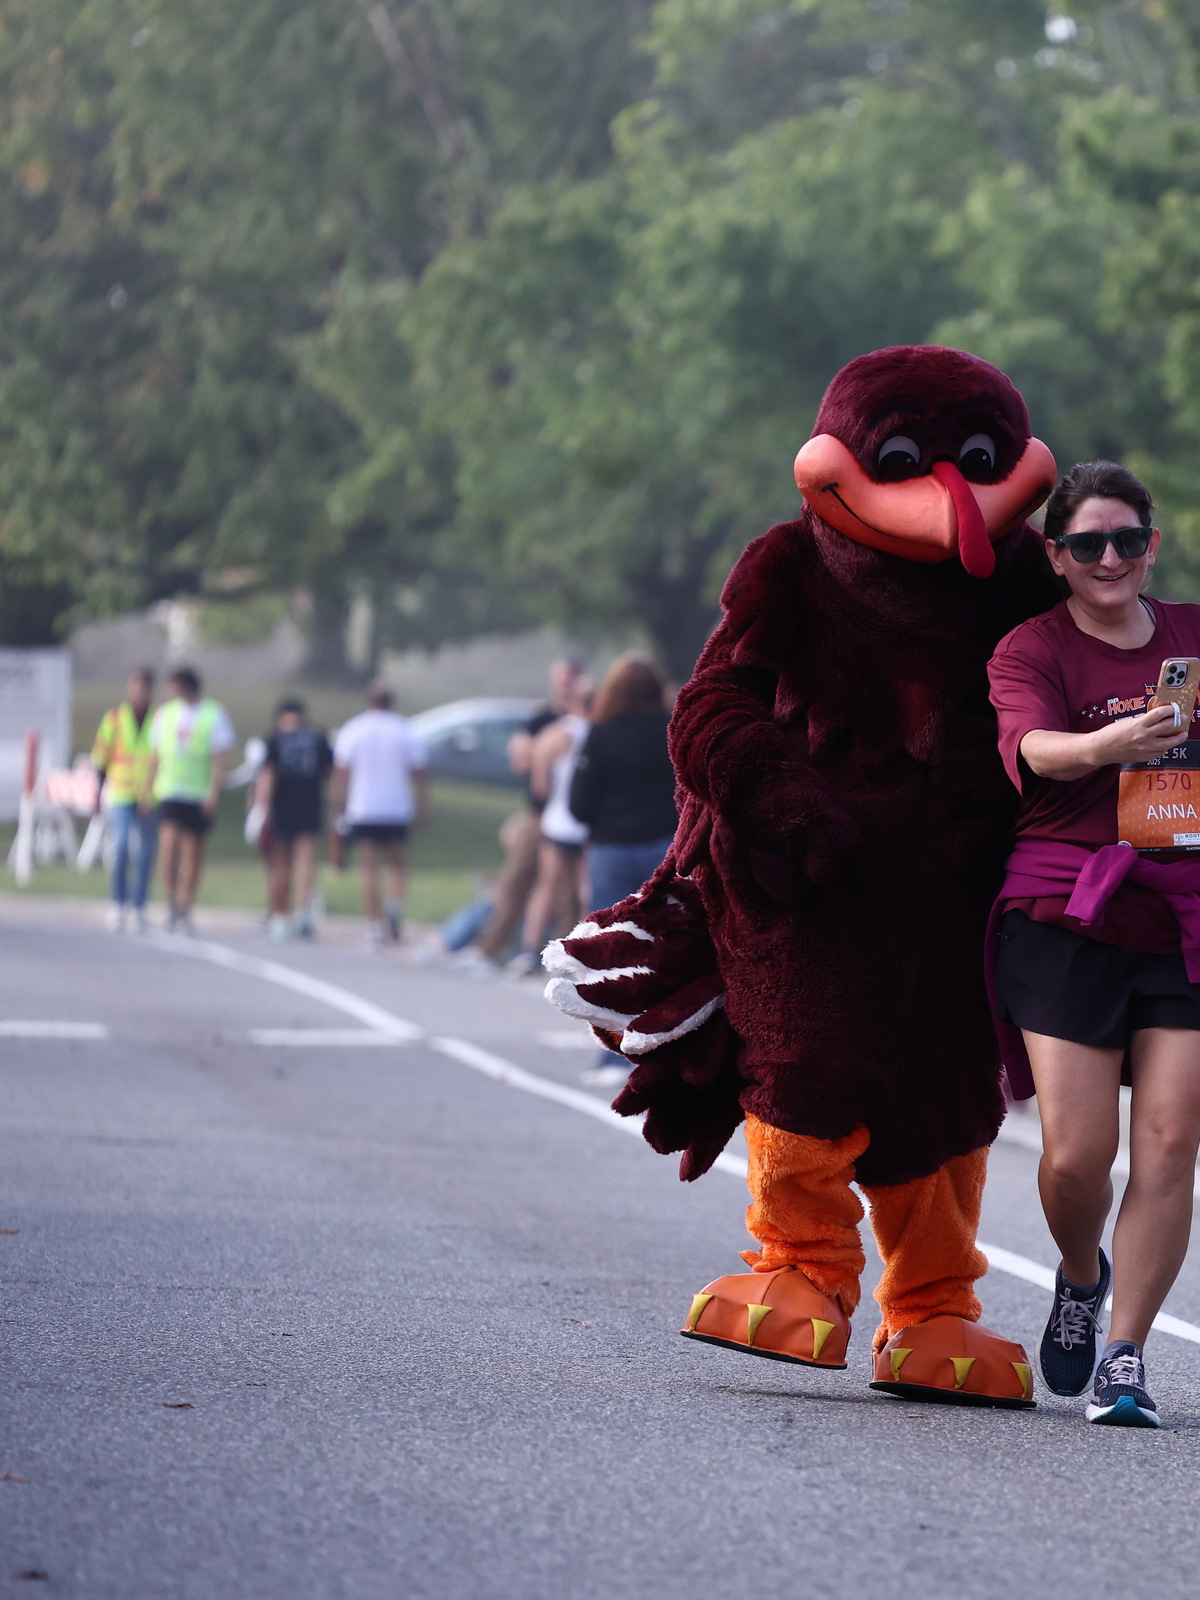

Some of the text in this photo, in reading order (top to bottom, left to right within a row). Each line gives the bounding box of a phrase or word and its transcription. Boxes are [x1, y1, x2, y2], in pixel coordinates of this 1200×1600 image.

[1107, 696, 1146, 716] HOKIE
[1171, 747, 1187, 759] 5K
[1145, 772, 1192, 791] 1570
[1146, 803, 1198, 820] ANNA
